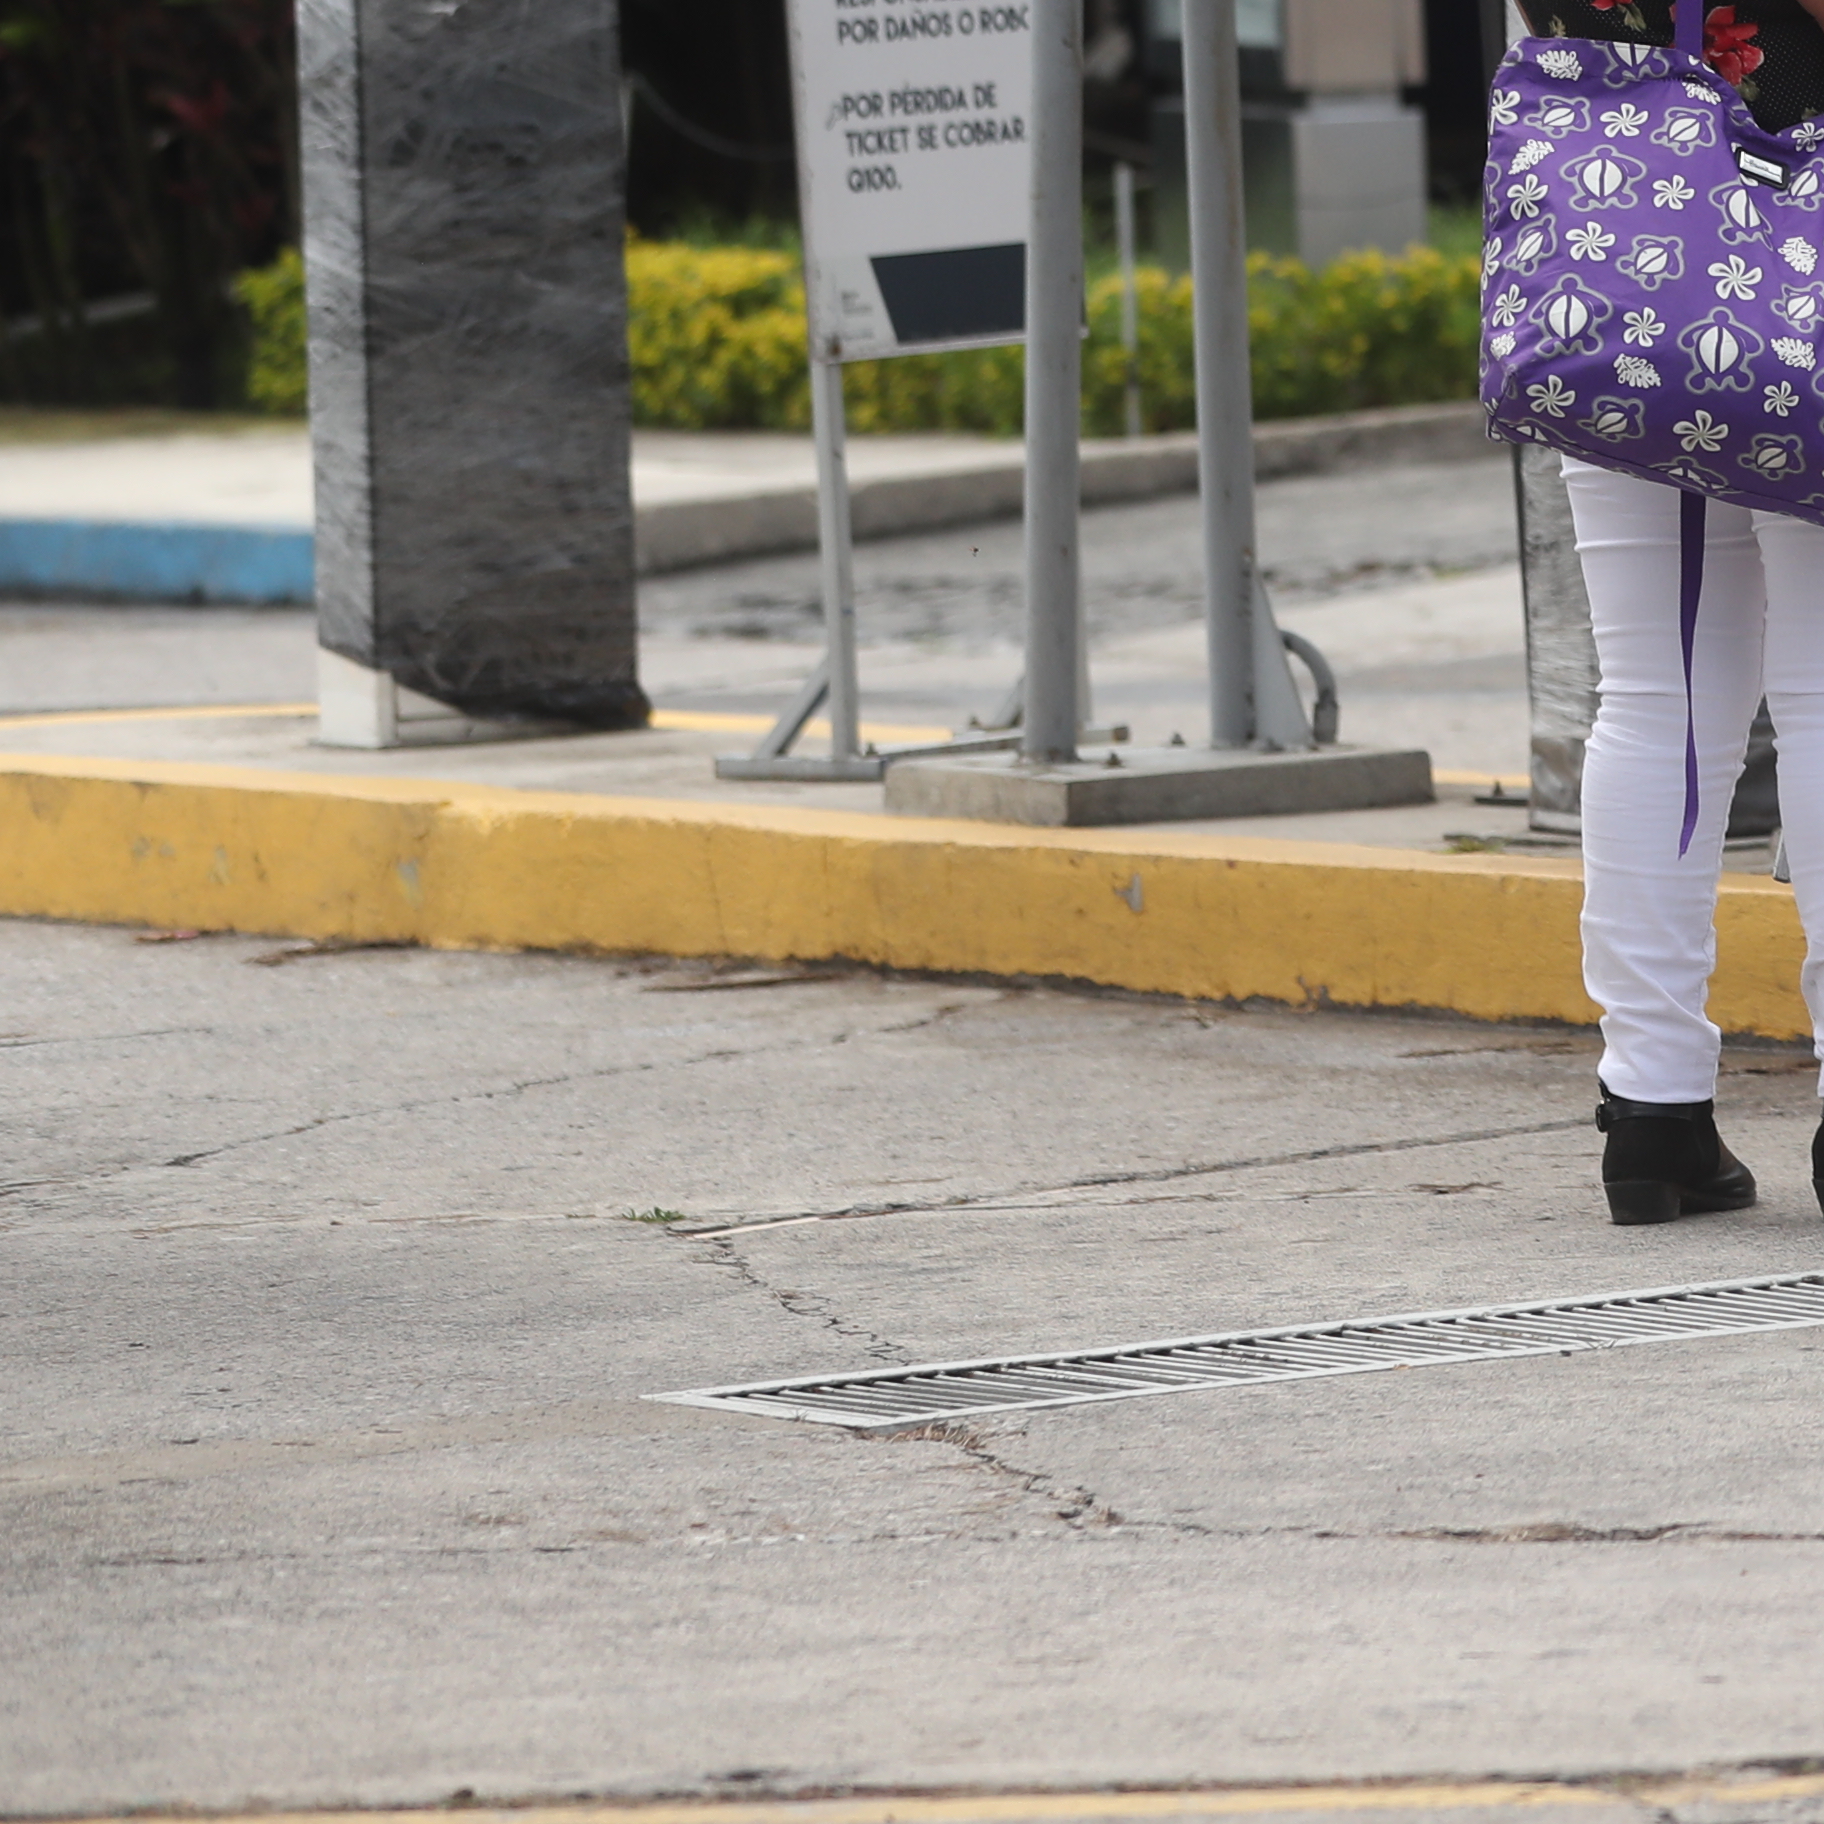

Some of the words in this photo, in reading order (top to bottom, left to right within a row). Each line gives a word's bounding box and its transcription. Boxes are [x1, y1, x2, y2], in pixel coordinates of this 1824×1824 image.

[838, 19, 879, 45] POR
[885, 10, 952, 41] DAÑOS
[959, 11, 975, 35] O
[843, 93, 883, 120] POR
[890, 81, 967, 116] PÉRDIDA
[973, 81, 996, 109] DE
[845, 127, 909, 156] TICKET
[918, 124, 938, 149] SE
